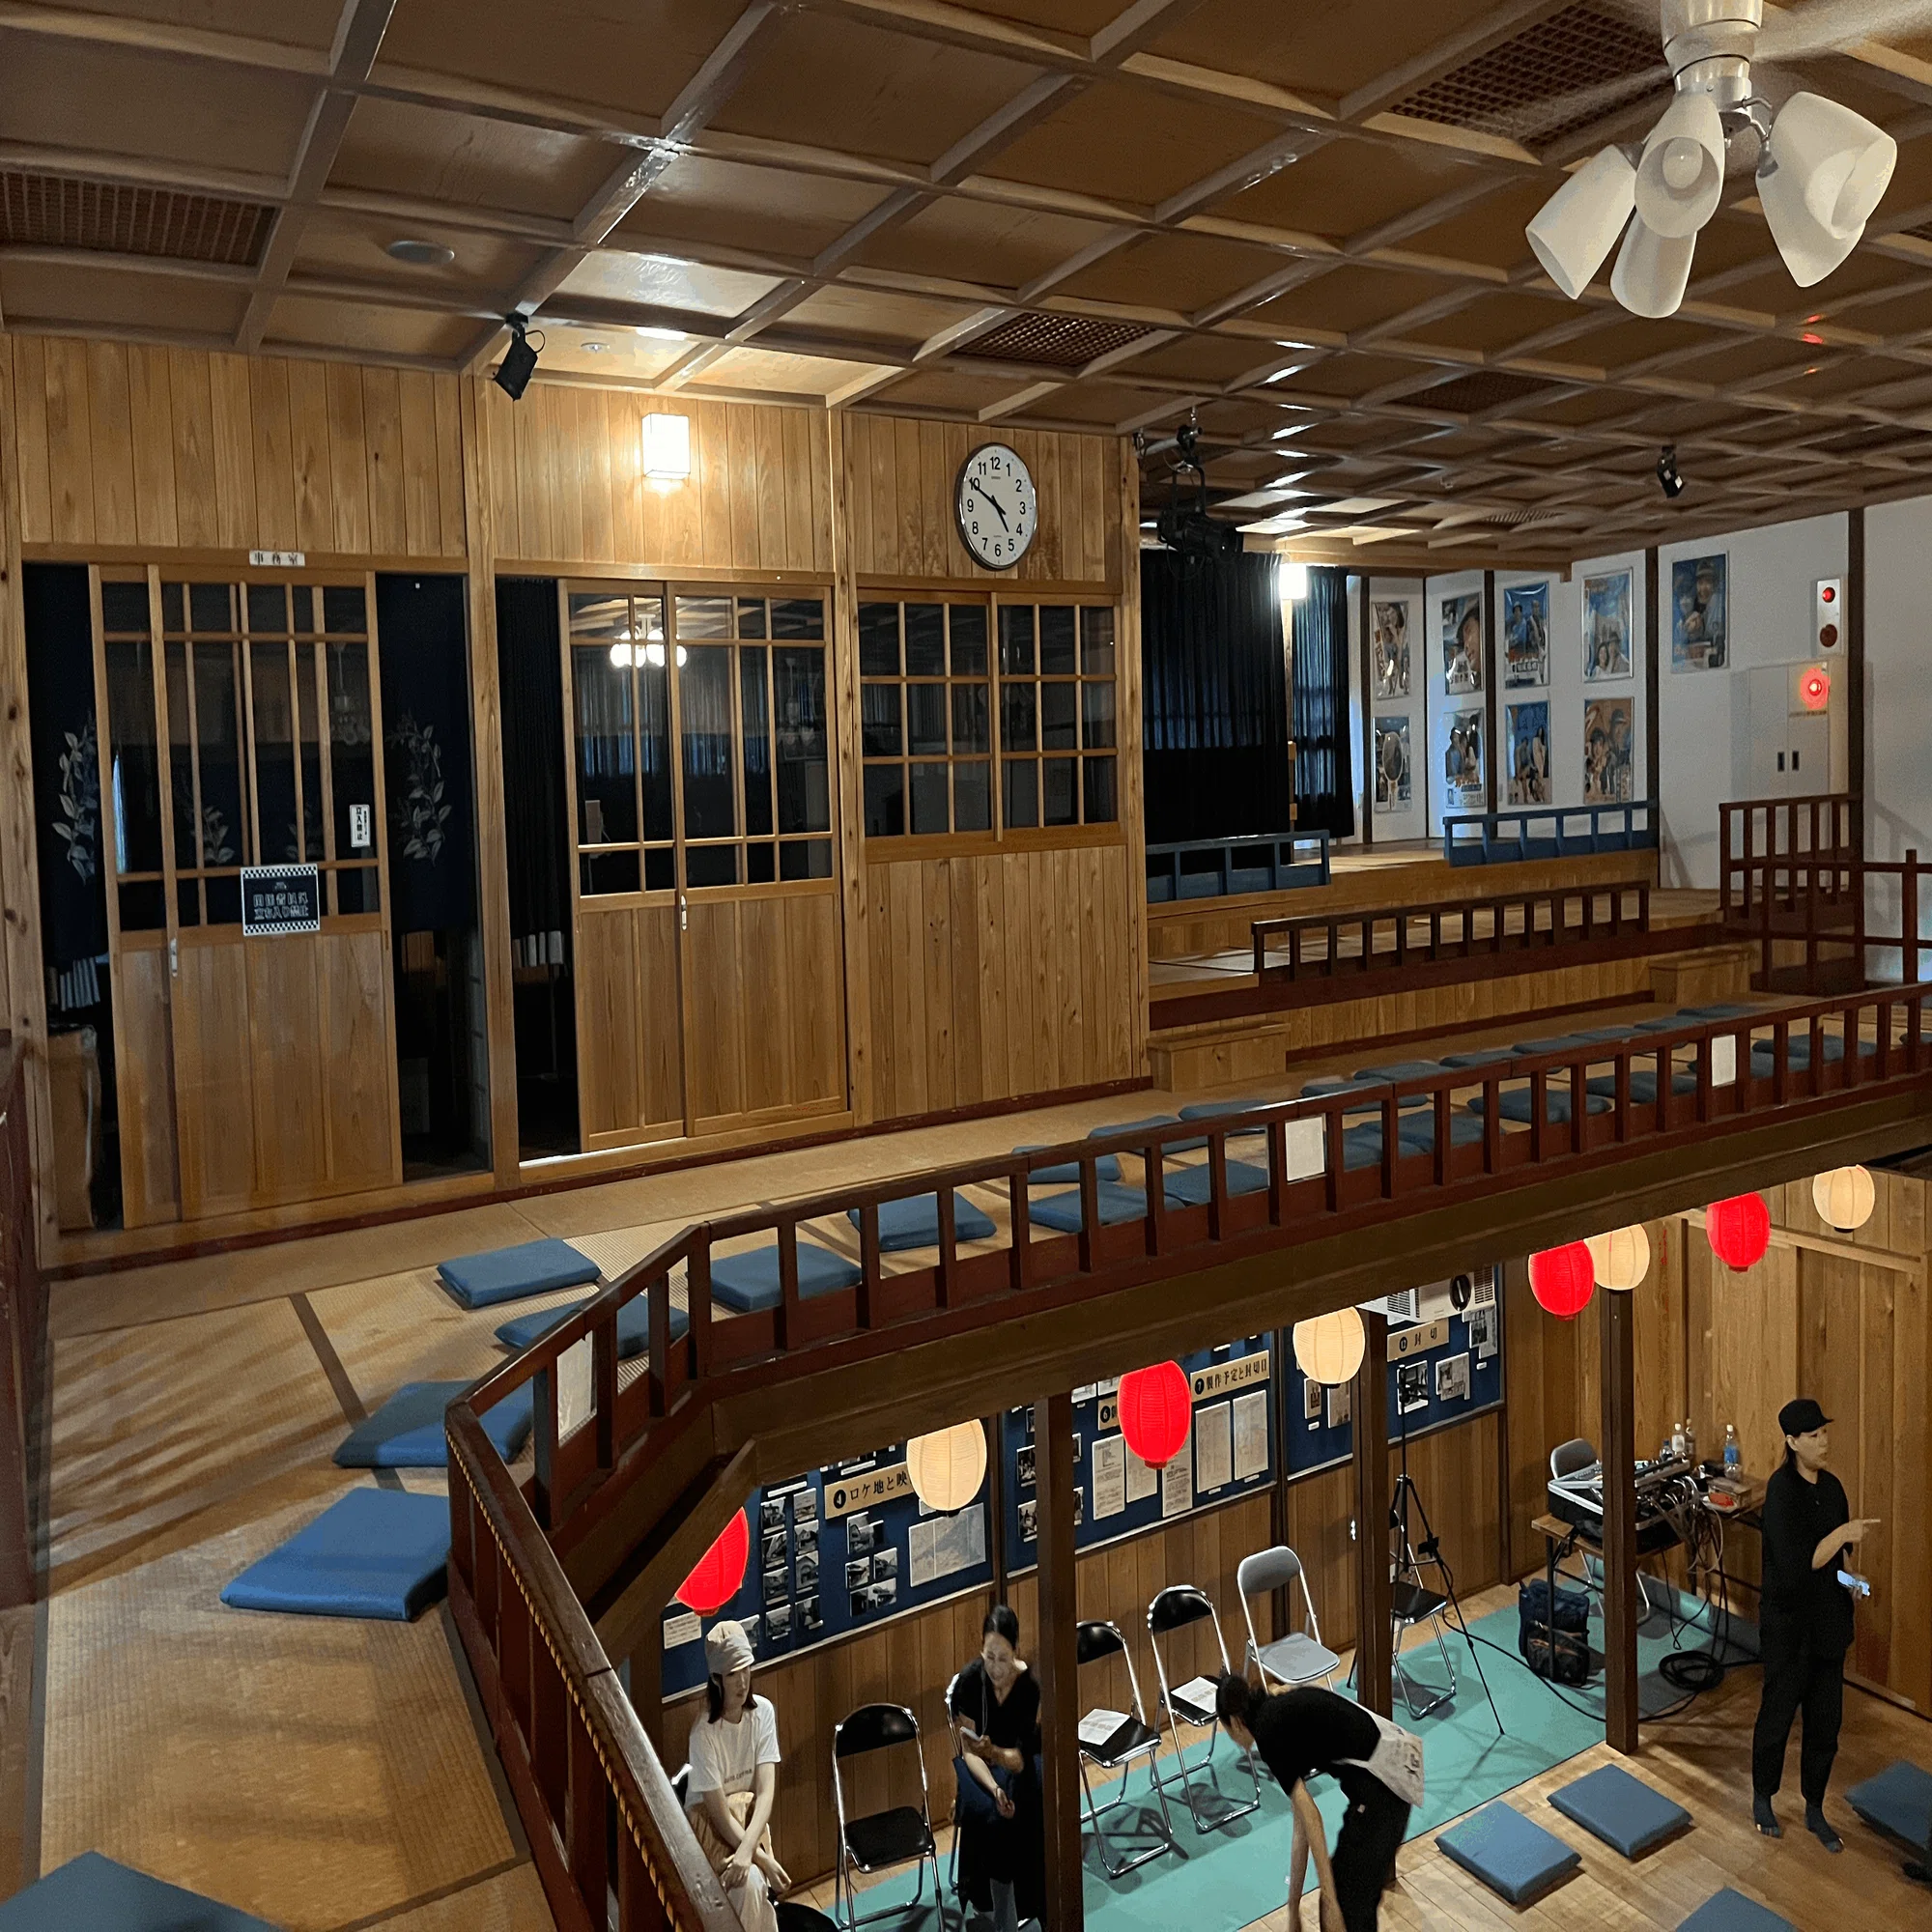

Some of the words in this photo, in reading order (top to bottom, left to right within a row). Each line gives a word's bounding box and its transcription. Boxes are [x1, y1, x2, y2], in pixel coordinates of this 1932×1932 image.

[978, 462, 987, 475] 11
[990, 456, 1001, 470] 12
[1006, 463, 1010, 477] 1
[969, 477, 980, 491] 10
[1015, 479, 1022, 492] 2
[967, 498, 974, 513] 9
[1019, 501, 1026, 515] 3
[972, 522, 979, 535] 8
[1015, 523, 1023, 536] 4
[981, 537, 988, 551] 7
[995, 544, 1002, 557] 6
[1008, 538, 1015, 552] 5
[850, 1470, 911, 1500] ロケ地と映
